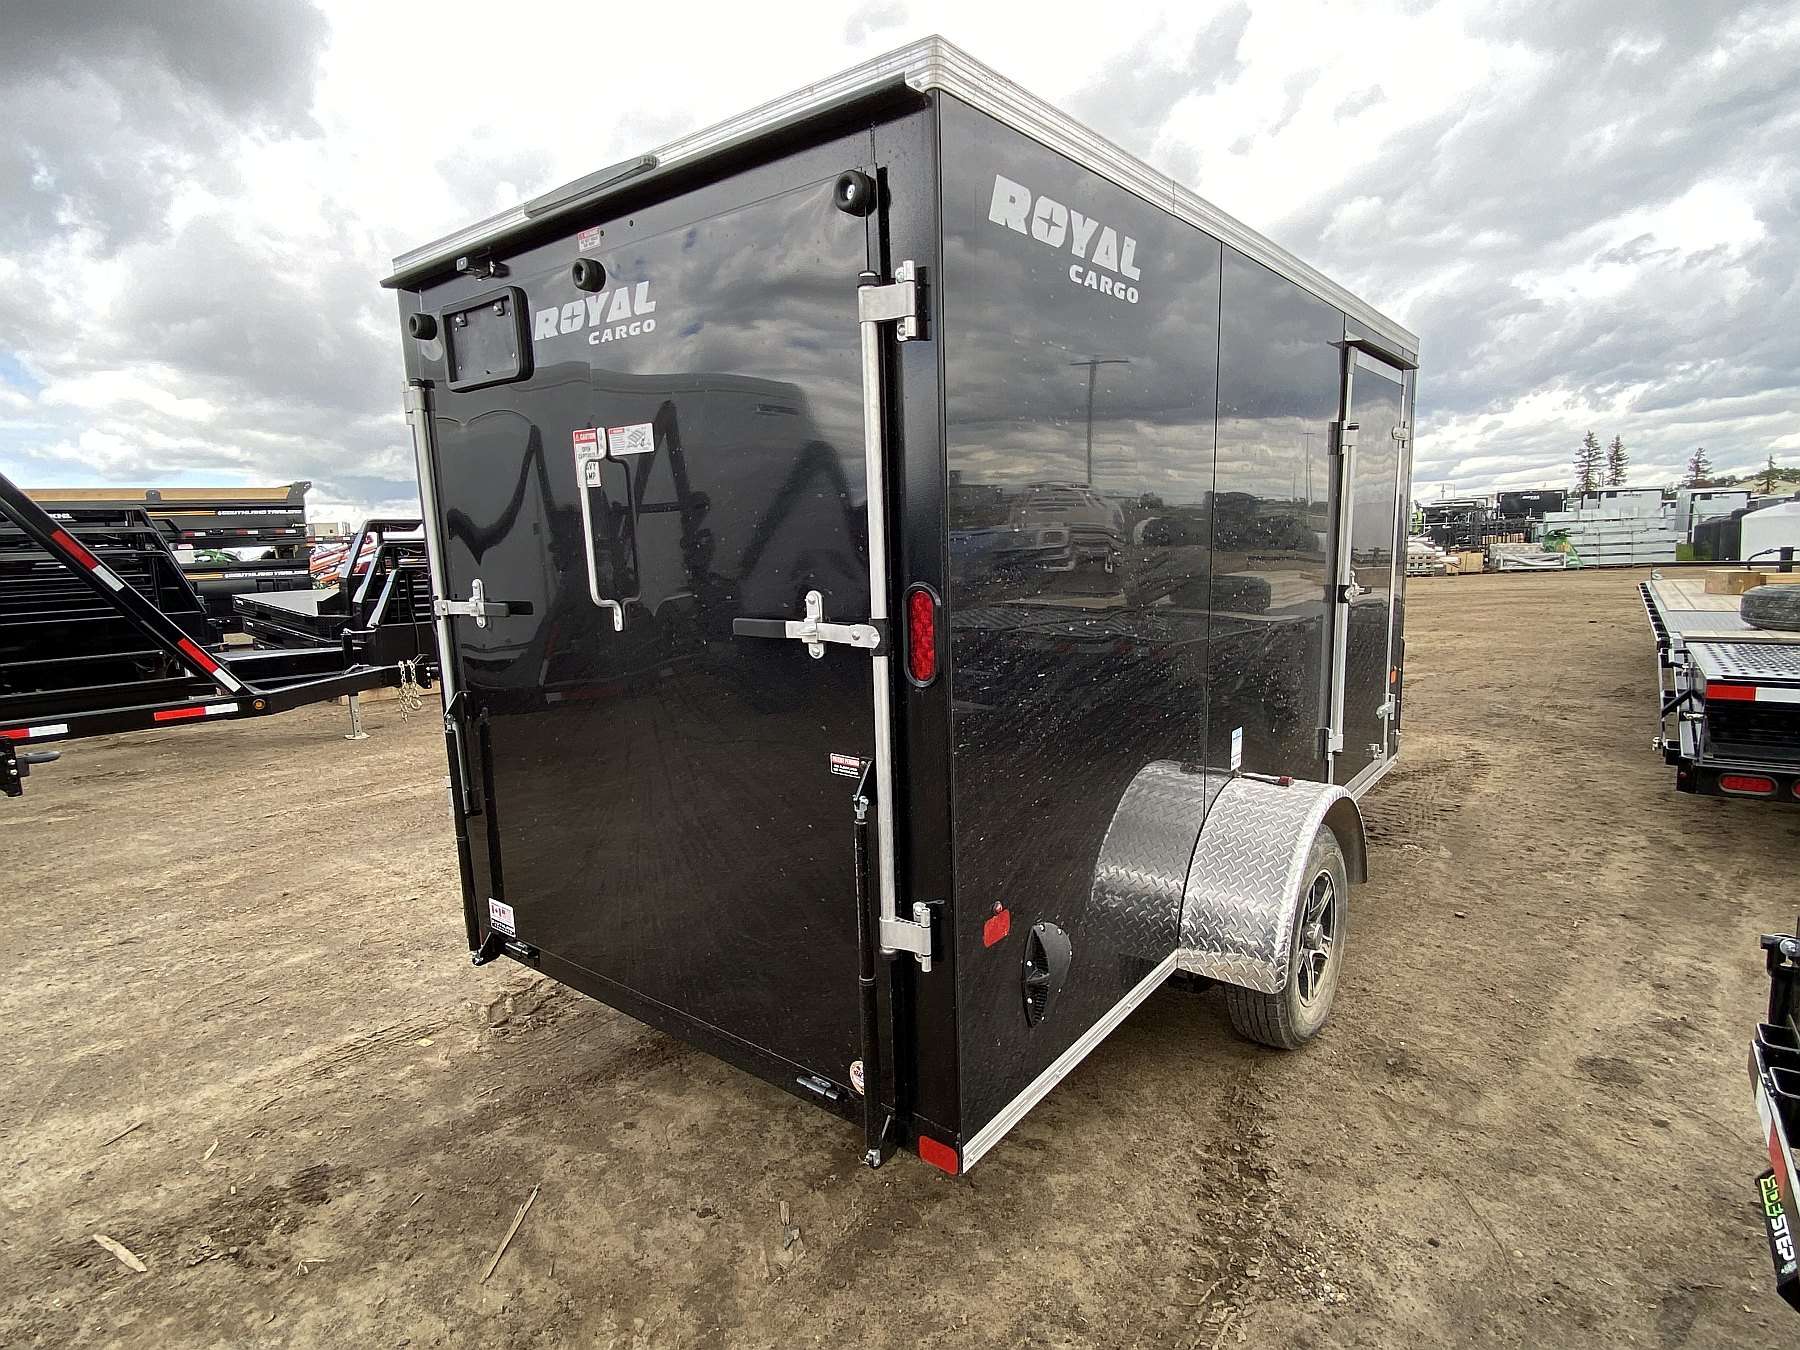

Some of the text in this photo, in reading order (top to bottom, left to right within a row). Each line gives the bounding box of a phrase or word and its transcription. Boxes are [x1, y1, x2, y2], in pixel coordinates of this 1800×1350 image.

[988, 174, 1141, 281] ROYAL
[1069, 264, 1139, 304] CARGO
[534, 280, 656, 341] ROYAL
[588, 319, 656, 345] CARGO
